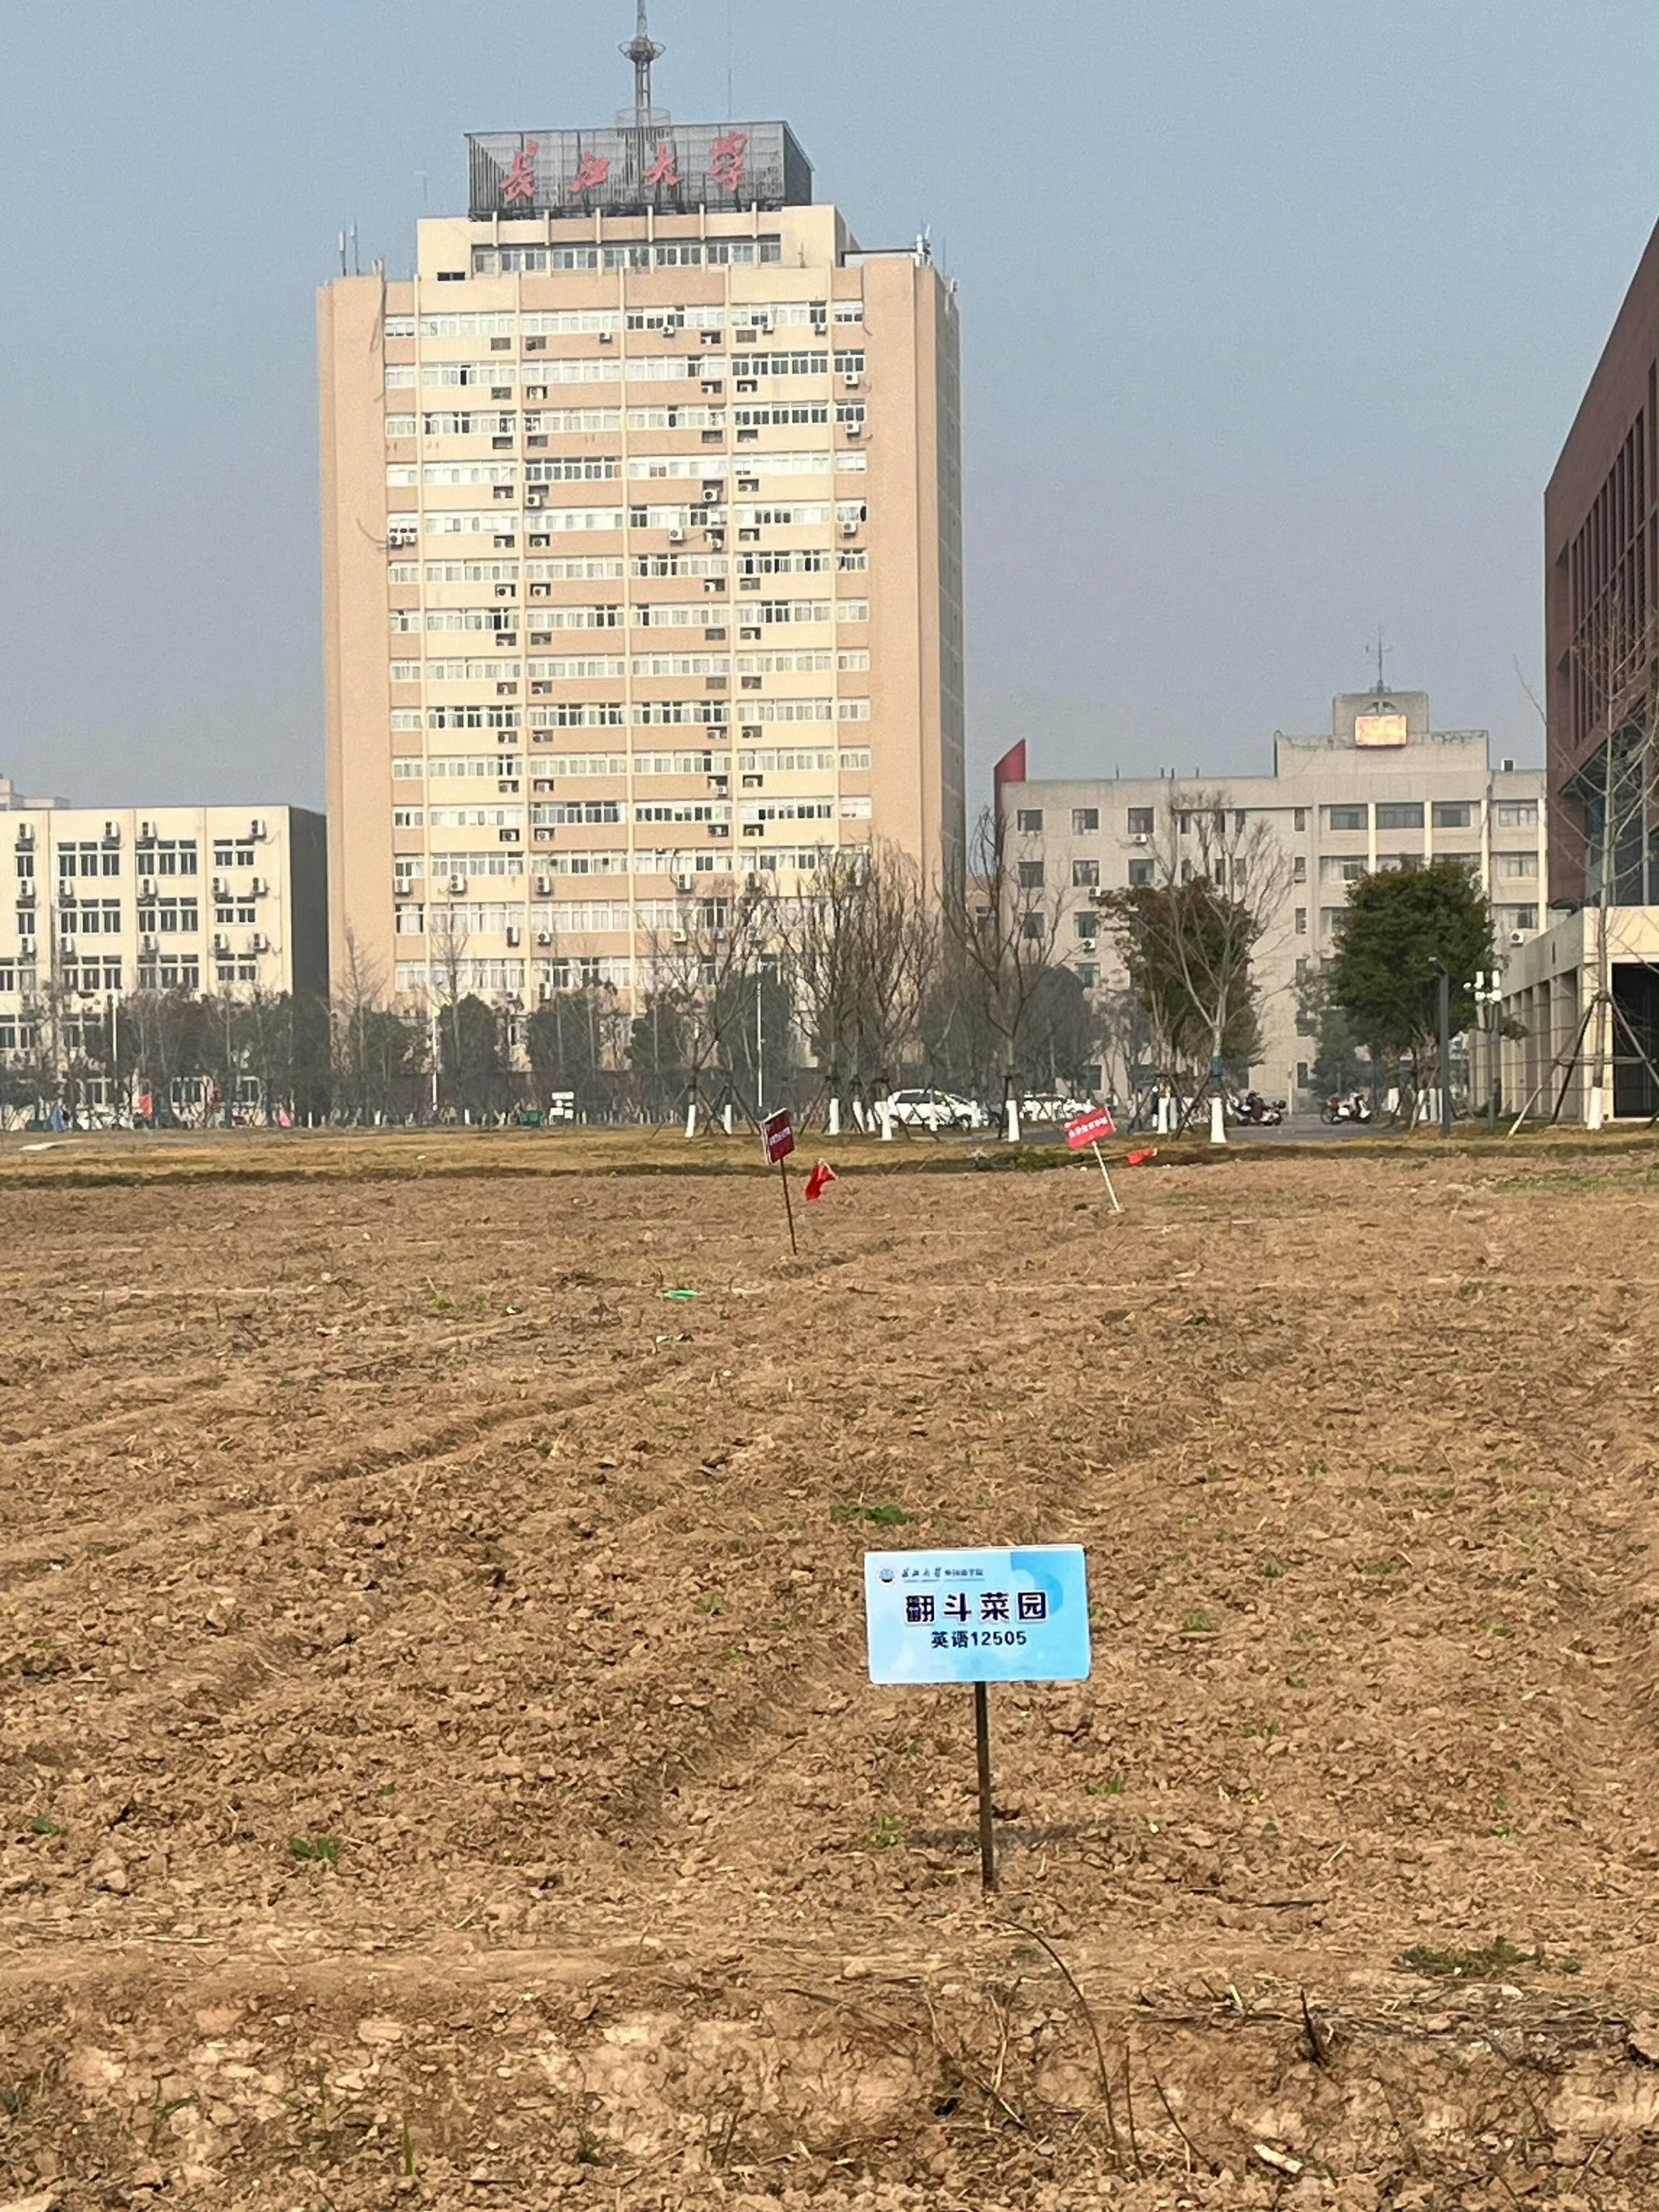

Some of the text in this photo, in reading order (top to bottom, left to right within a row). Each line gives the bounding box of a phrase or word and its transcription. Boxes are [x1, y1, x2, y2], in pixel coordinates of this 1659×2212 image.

[906, 1592, 1047, 1623] 翻斗菜园
[931, 1631, 1027, 1649] 英语12505
